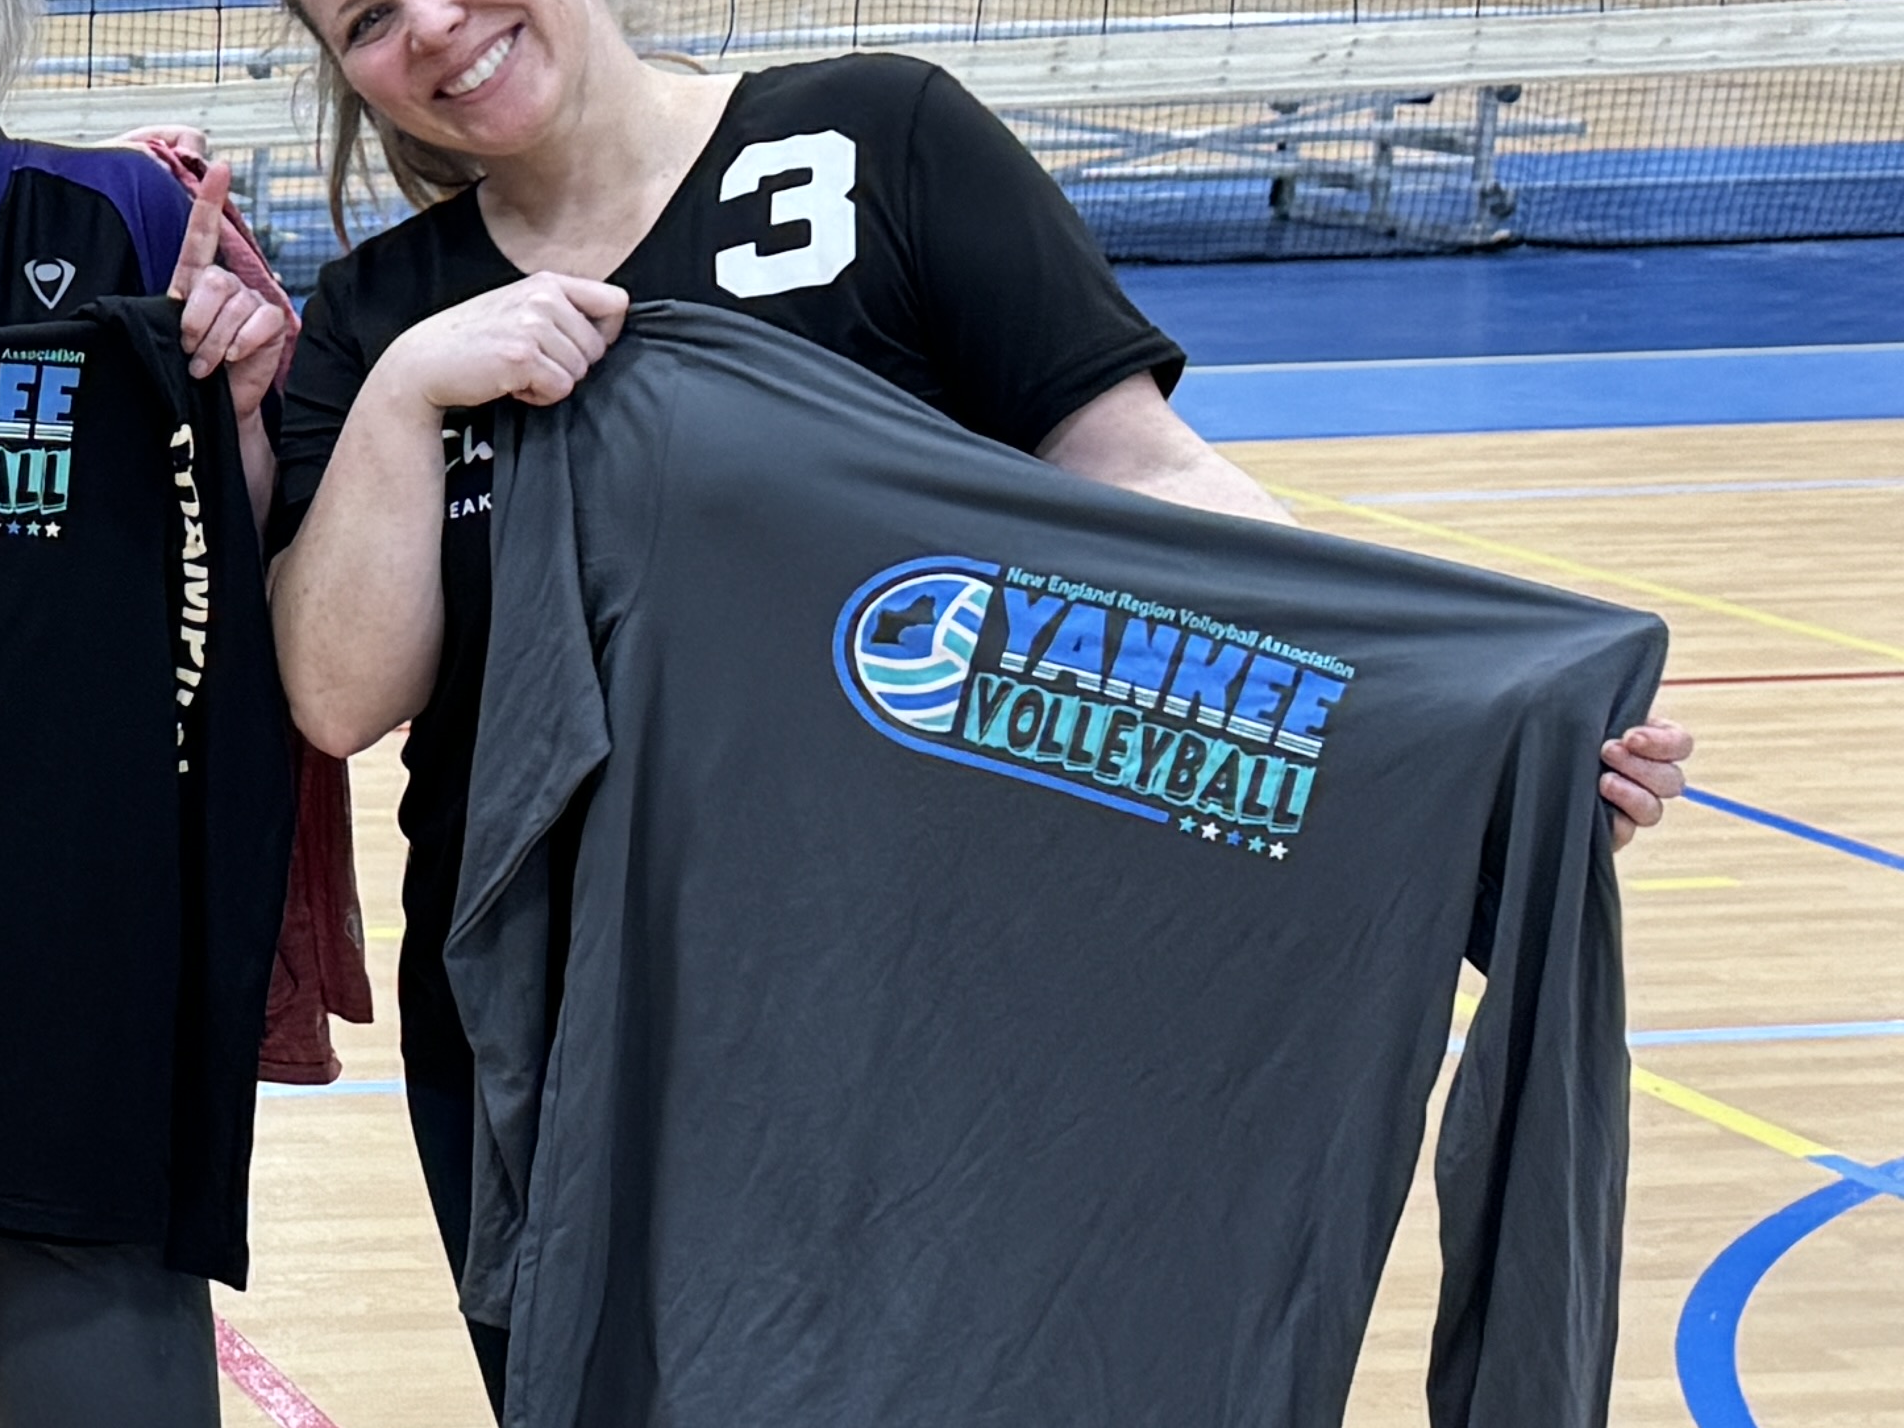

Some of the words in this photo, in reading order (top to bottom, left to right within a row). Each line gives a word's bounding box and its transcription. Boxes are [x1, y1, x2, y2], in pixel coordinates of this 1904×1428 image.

[715, 129, 856, 299] 3
[1000, 587, 1347, 759] YANKEE
[1006, 567, 1045, 589] New
[1048, 575, 1114, 605] England
[1117, 593, 1175, 622] Region
[1180, 608, 1257, 646] Volleyball
[1260, 635, 1355, 678] Association
[964, 672, 1316, 833] VOLLEYBALL
